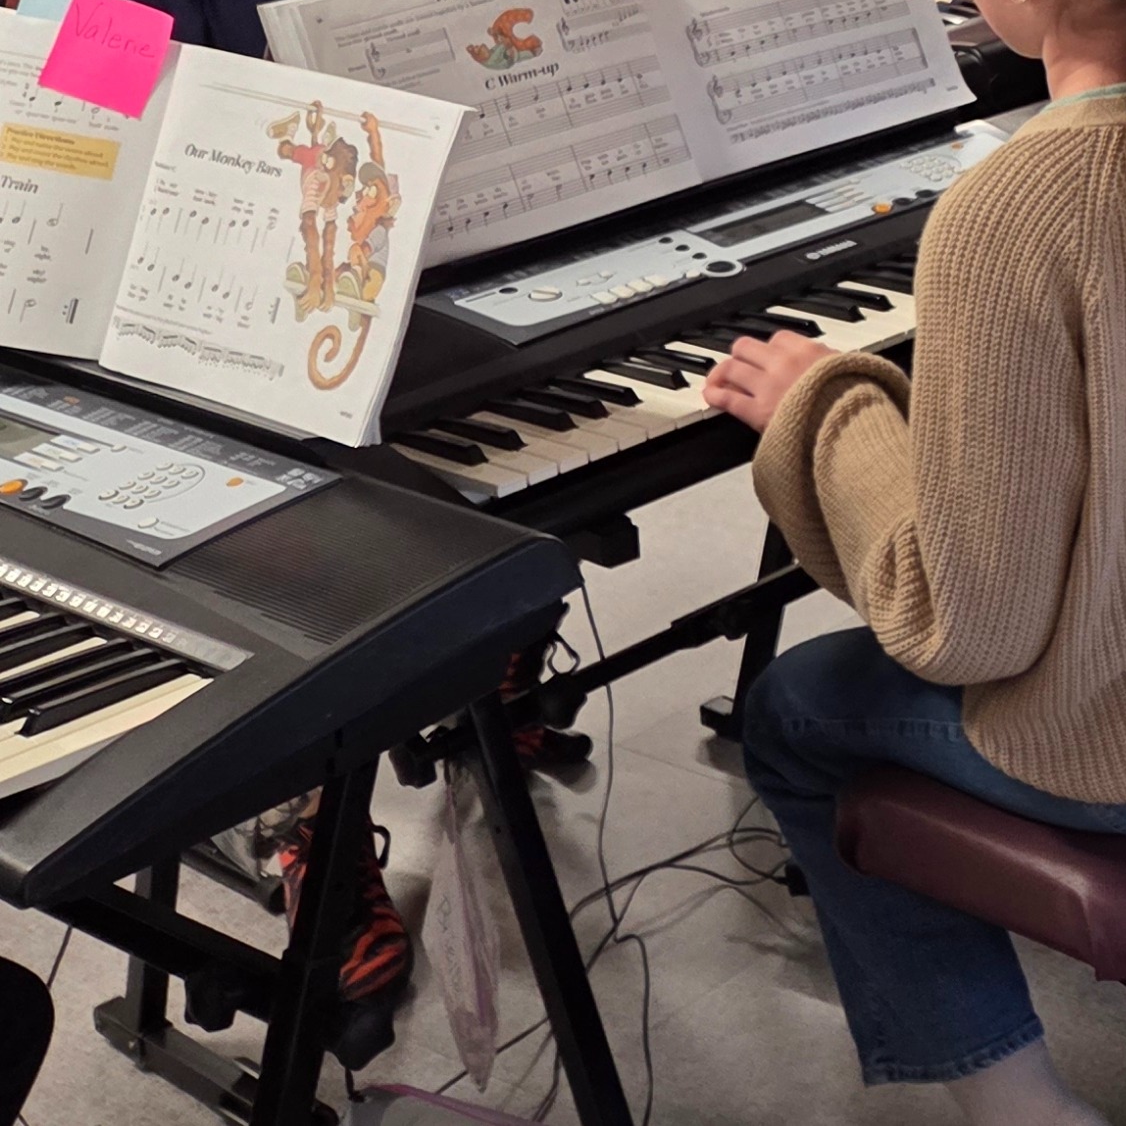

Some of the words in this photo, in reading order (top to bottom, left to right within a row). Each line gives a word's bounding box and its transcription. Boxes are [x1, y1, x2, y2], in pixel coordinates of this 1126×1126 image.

[76, 2, 155, 58] Valerie
[485, 76, 497, 90] C
[498, 61, 560, 87] Warm-up
[184, 143, 208, 160] Our
[210, 149, 253, 174] Monkey
[256, 160, 283, 178] Bars
[1, 175, 39, 194] Train
